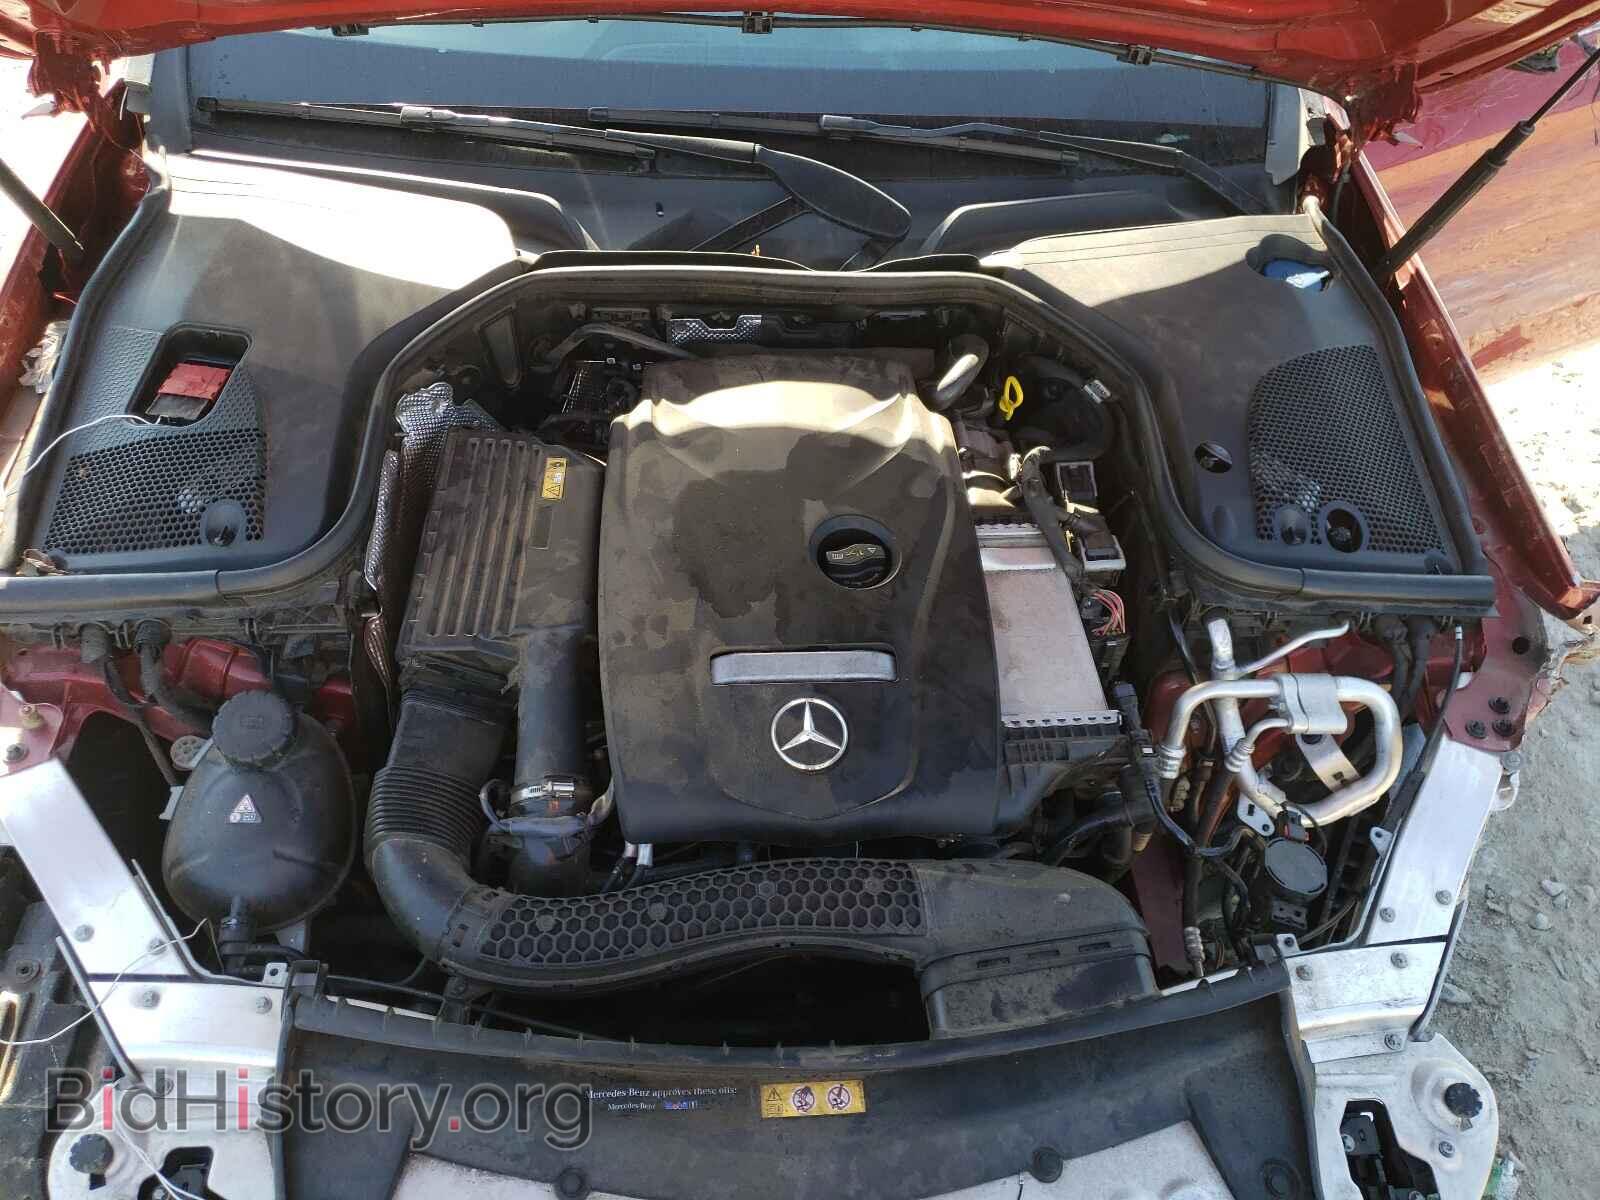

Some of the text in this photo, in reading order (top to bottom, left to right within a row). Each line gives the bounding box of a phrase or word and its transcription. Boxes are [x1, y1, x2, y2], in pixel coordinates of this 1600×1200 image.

[585, 1087, 650, 1099] Mercedes-Benz
[652, 1087, 692, 1098] approves
[693, 1087, 717, 1096] these
